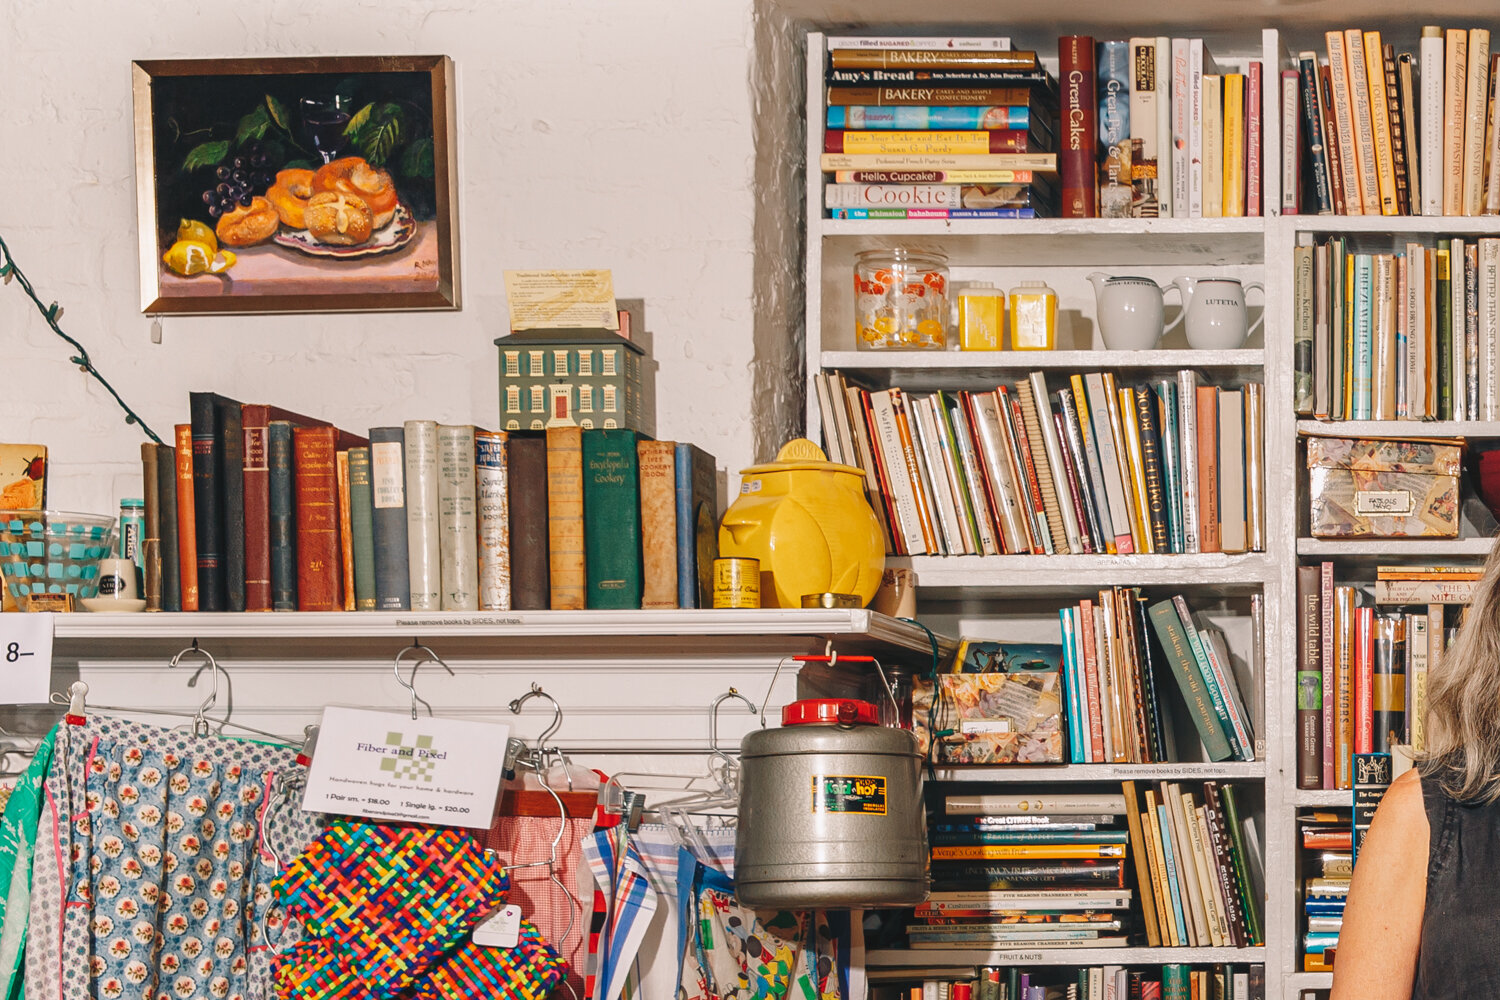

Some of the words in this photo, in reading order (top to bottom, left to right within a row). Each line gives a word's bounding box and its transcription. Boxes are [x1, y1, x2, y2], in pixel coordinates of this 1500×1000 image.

[832, 71, 870, 83] Amy's
[873, 71, 914, 80] Bread
[885, 89, 934, 100] BAKERY
[1068, 71, 1085, 150] GreatCakes
[860, 172, 888, 182] Hello,
[890, 172, 936, 183] Cupcake!
[865, 185, 945, 204] Cookie
[357, 742, 387, 754] Fiber
[391, 748, 414, 757] and
[418, 749, 447, 760] Pixel
[856, 780, 878, 795] hot
[368, 797, 390, 805] $18.00
[405, 801, 426, 811] Single
[445, 805, 470, 814] $20.00
